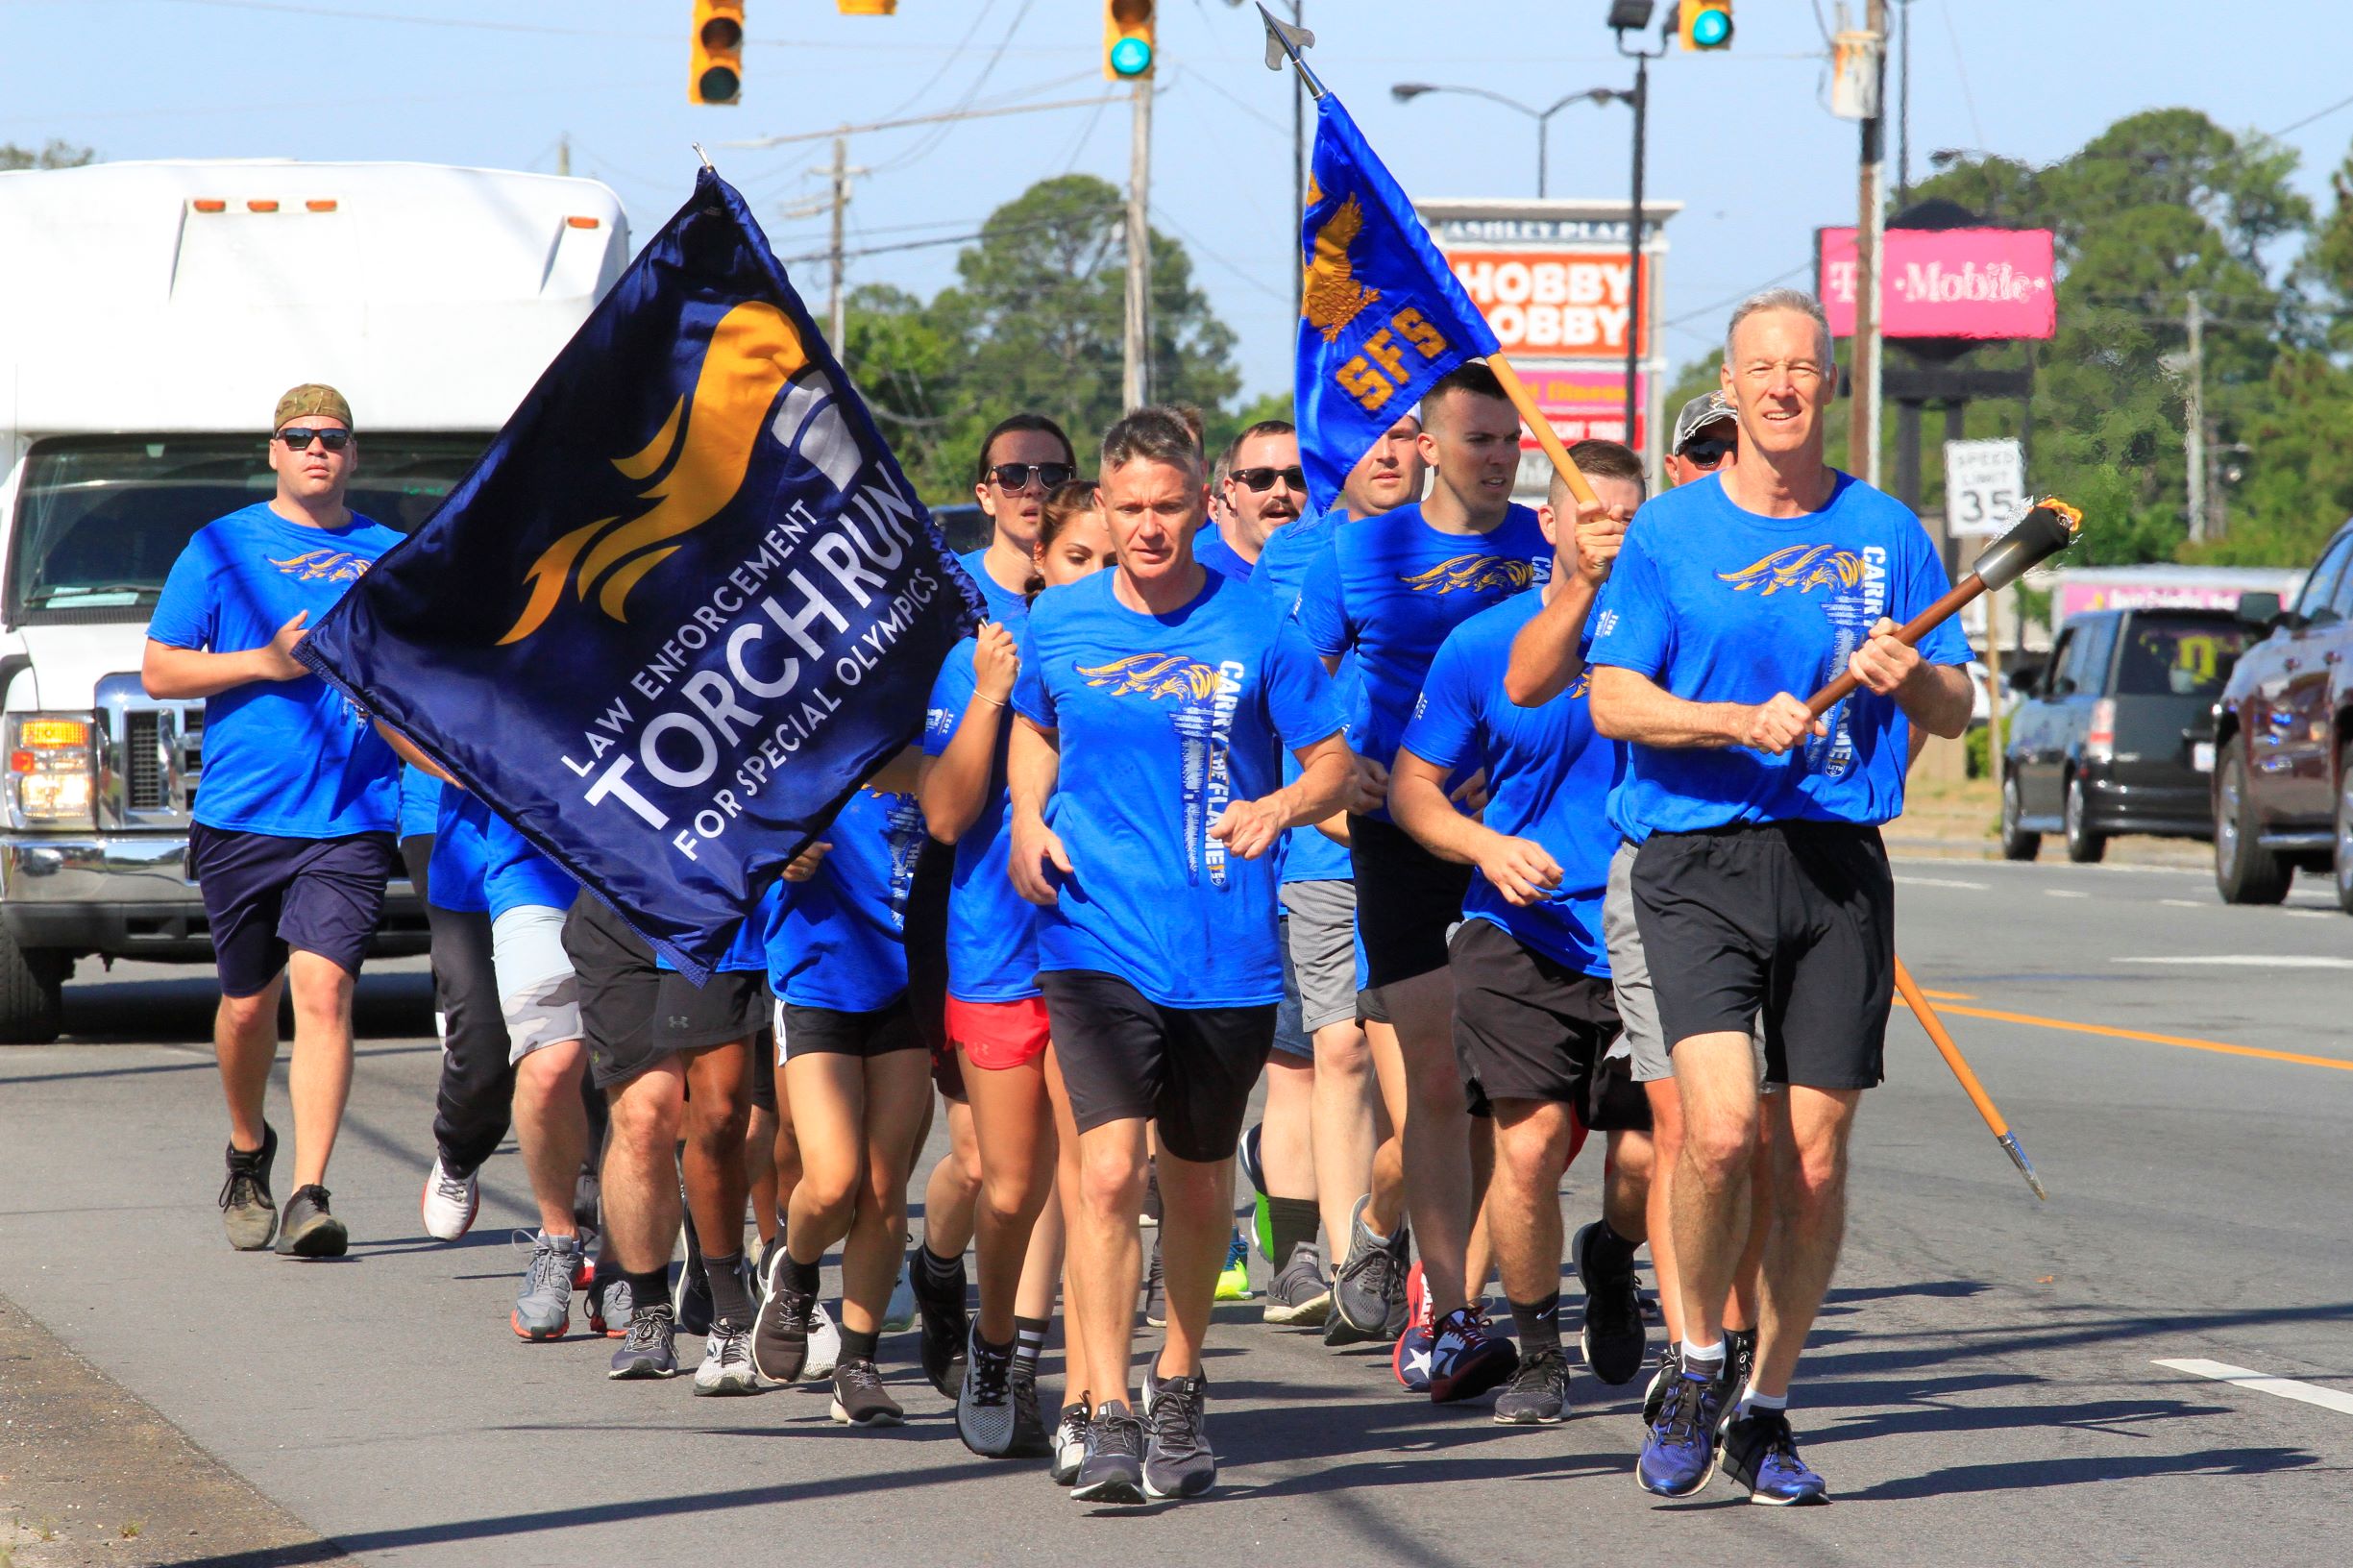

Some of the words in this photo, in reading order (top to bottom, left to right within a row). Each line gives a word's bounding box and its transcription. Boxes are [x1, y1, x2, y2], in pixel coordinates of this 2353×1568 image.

[1451, 221, 1554, 240] ASHLEY
[1455, 261, 1631, 305] HOBBY
[1487, 305, 1630, 346] OBBY
[1336, 306, 1448, 411] SFS
[1962, 490, 2013, 524] 35
[561, 697, 634, 778] LAW
[630, 499, 818, 701] ENFORCEMENT
[583, 568, 850, 831] TORCH
[809, 460, 919, 609] RUN
[1604, 614, 1619, 636] 2021
[672, 789, 743, 862] FOR
[736, 688, 843, 796] SPECIAL
[836, 568, 939, 686] OLYMPICS
[1211, 660, 1245, 744] CARRY
[942, 713, 955, 735] 2021
[1211, 749, 1227, 781] THE
